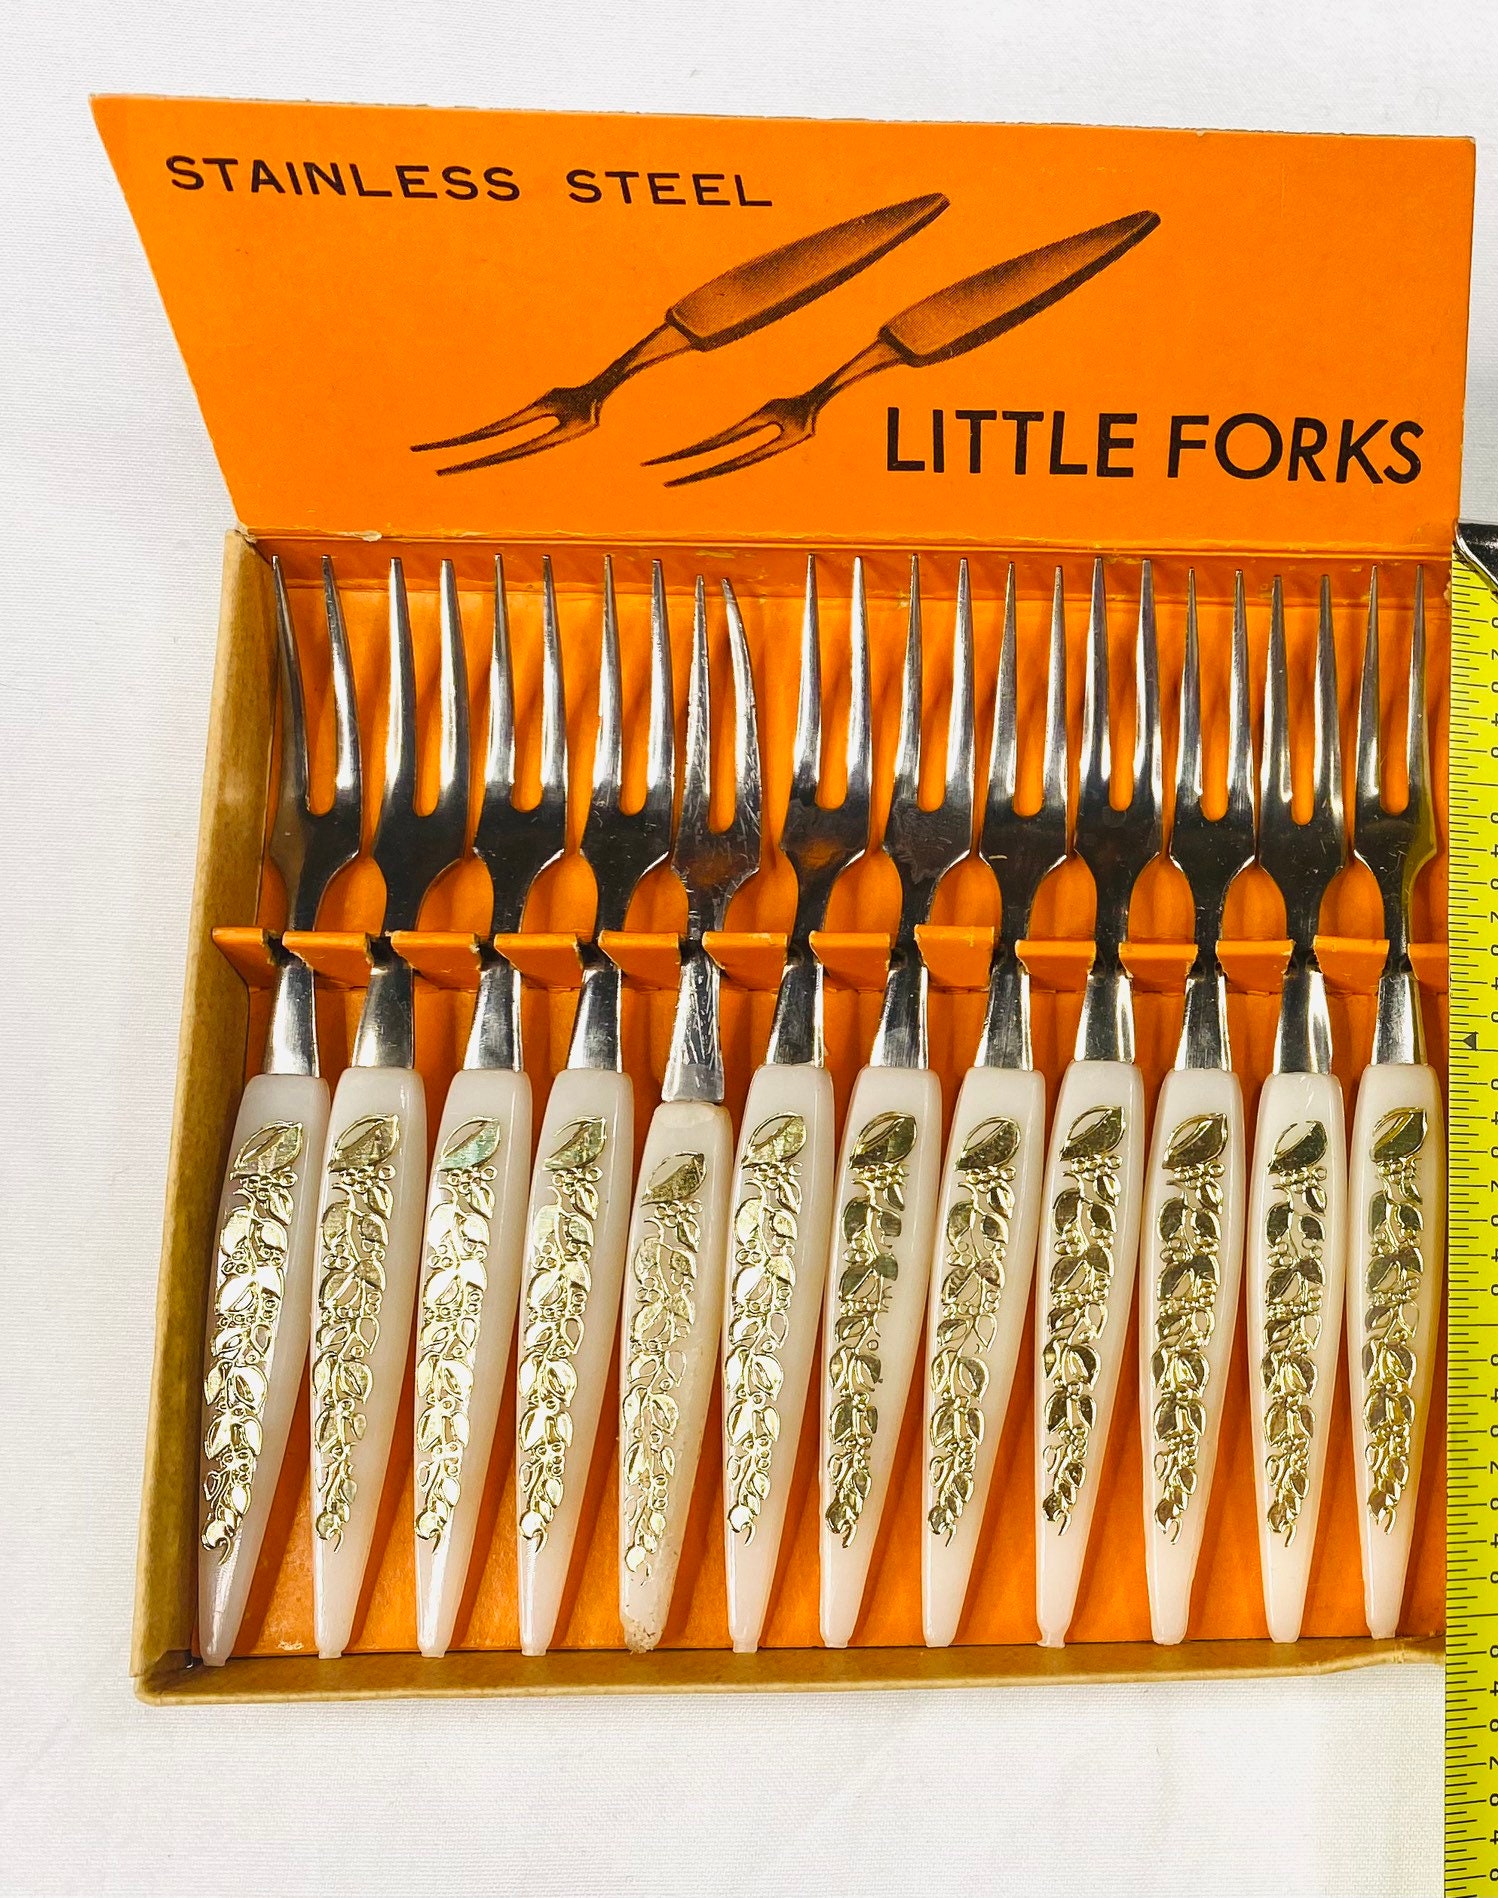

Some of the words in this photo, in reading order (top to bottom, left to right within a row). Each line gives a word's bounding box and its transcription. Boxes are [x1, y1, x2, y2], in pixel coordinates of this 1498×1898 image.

[166, 154, 521, 204] STAINLESS
[566, 169, 775, 208] STEEL
[886, 405, 1139, 480] LITTLE
[1168, 412, 1426, 487] FORKS
